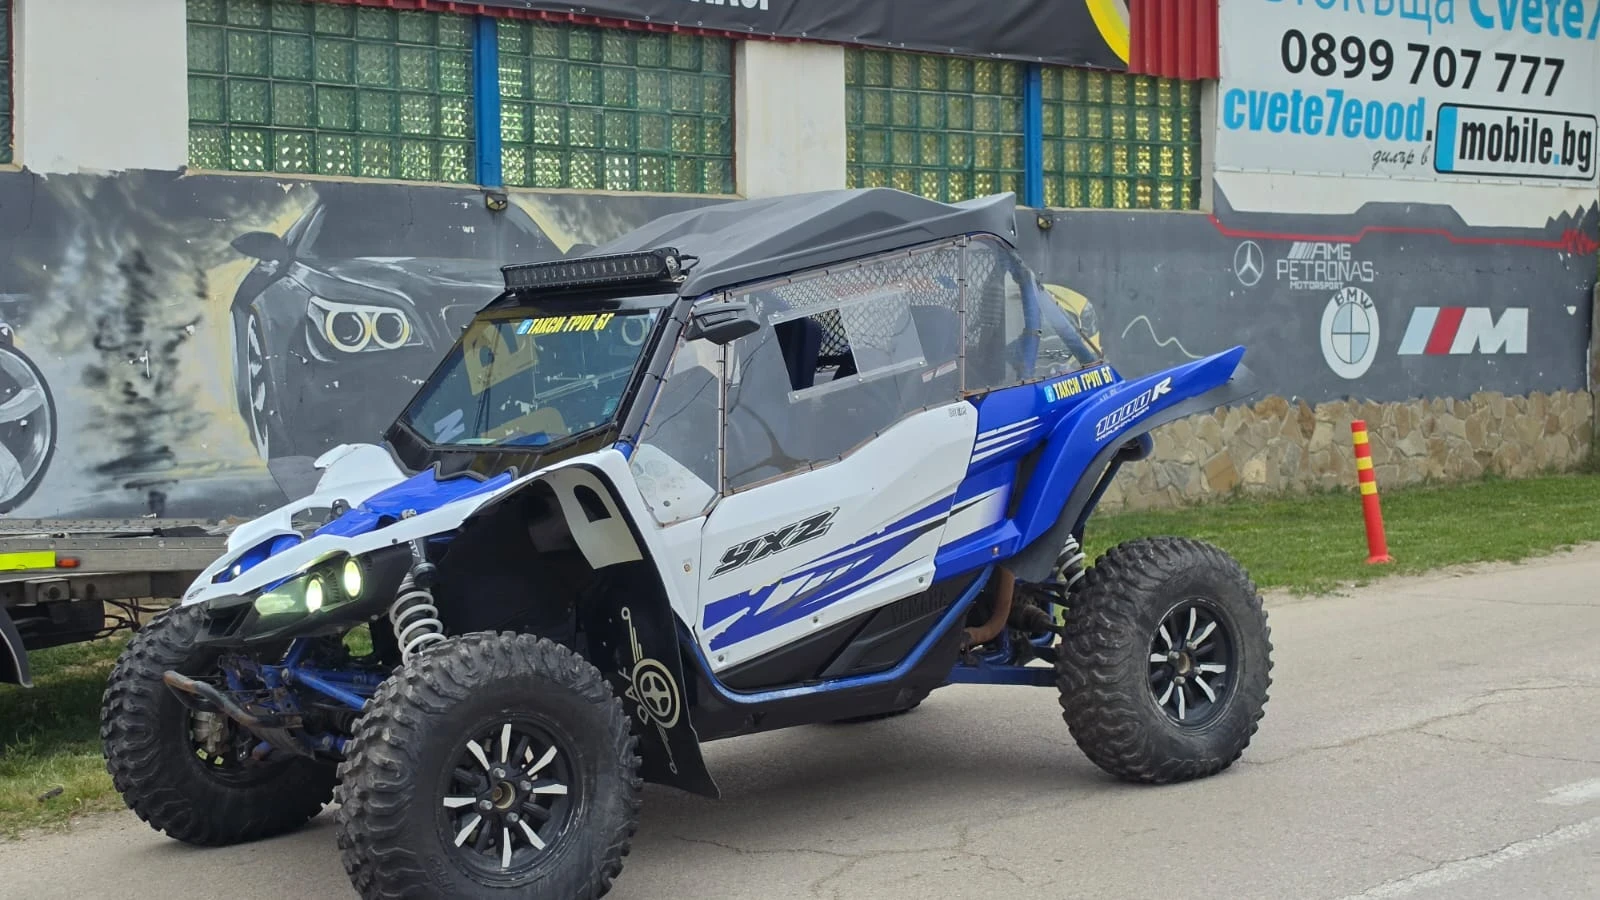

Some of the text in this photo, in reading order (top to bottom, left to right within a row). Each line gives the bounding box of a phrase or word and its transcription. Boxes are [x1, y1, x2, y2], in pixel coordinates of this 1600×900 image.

[1281, 29, 1564, 96] 0899 707 777
[1459, 116, 1592, 172] mobile.bg
[1311, 242, 1351, 260] AMG
[1277, 259, 1374, 282] PETRONAS
[1289, 281, 1345, 290] MOTORSPORT
[1335, 288, 1372, 309] BMW
[527, 317, 566, 335] ТАКСИ
[562, 314, 597, 332] ГРУП
[1053, 376, 1082, 400] ТАКСИ
[1080, 370, 1103, 391] ГРУП
[1101, 366, 1113, 384] БГ
